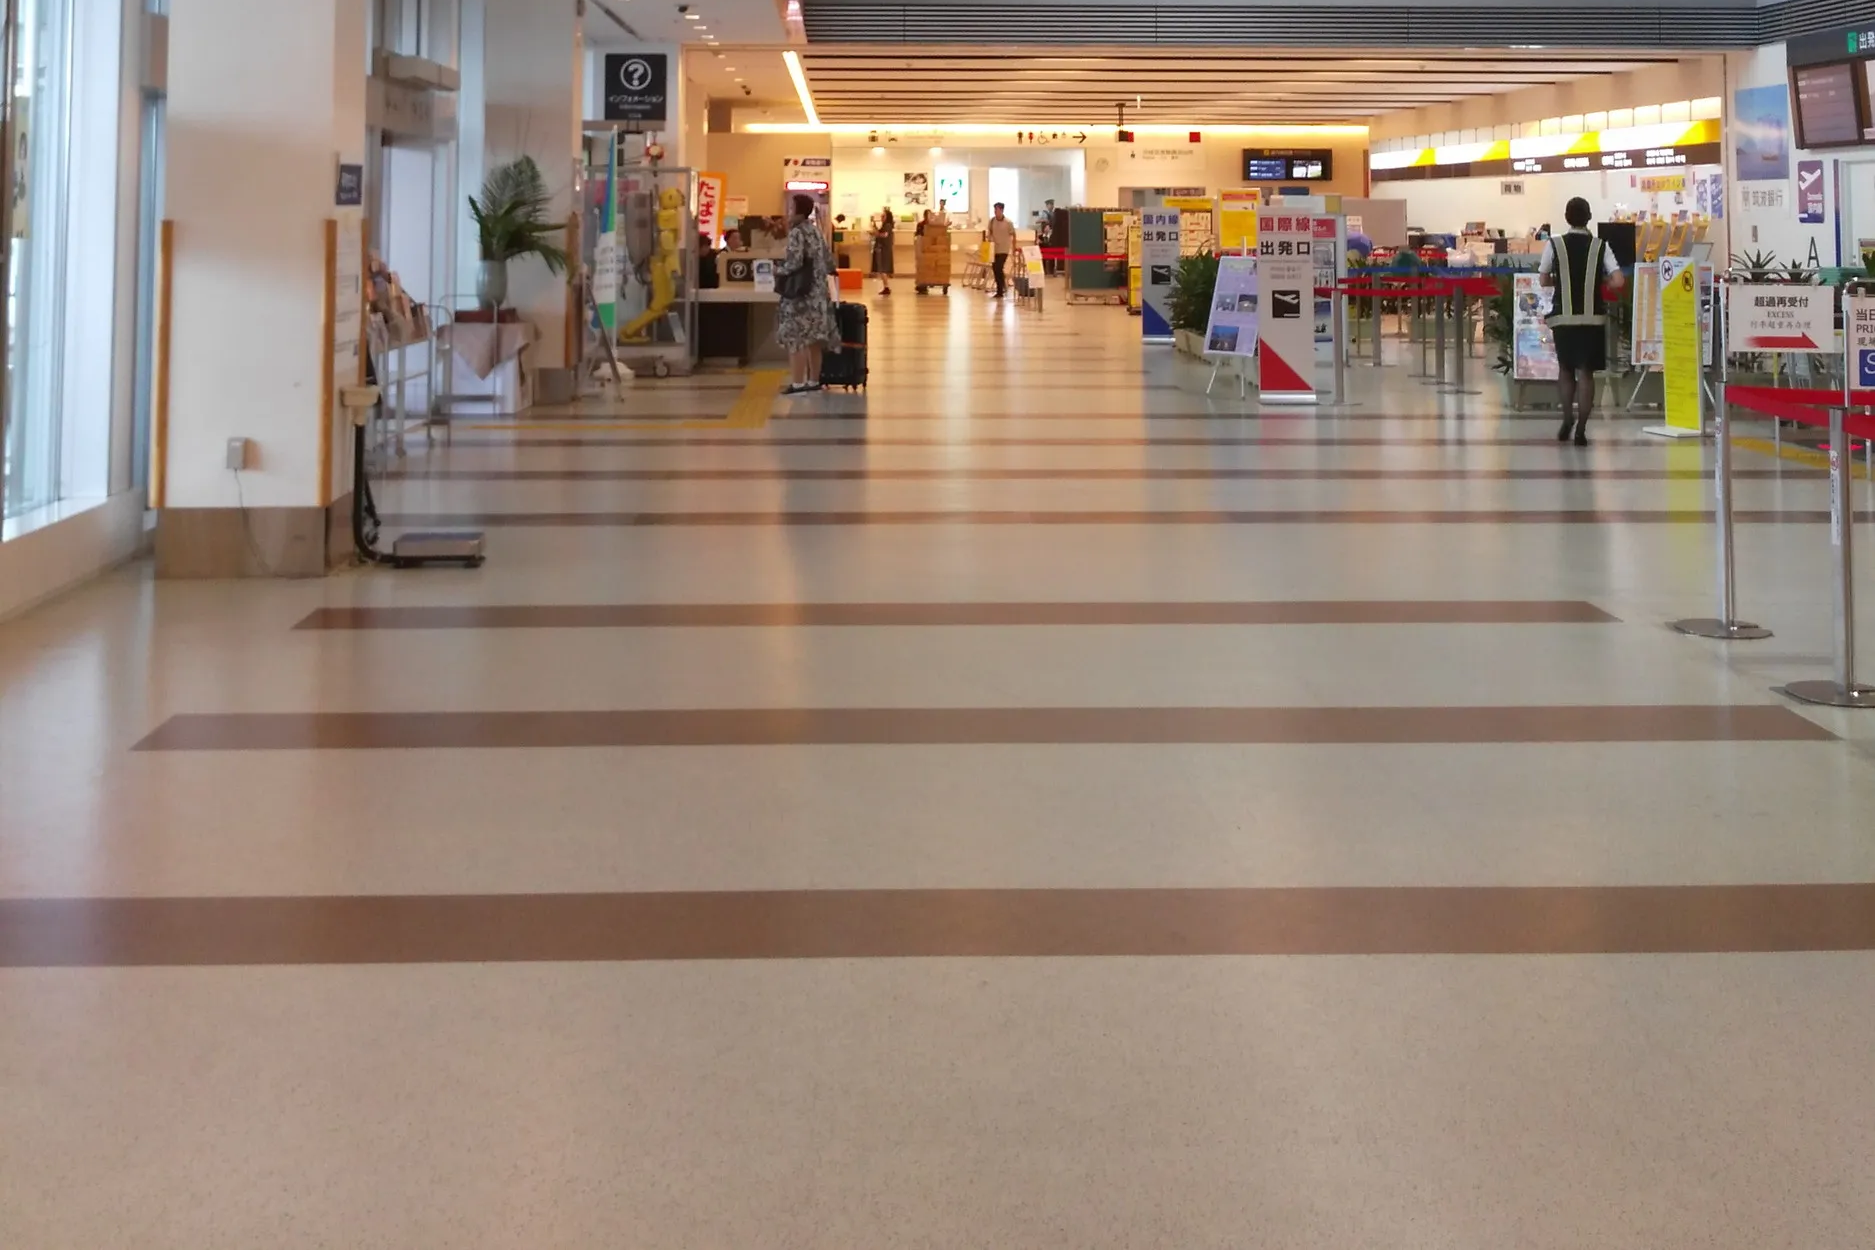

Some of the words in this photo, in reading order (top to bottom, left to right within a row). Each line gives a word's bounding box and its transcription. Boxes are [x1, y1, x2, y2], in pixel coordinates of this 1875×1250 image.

[1143, 214, 1178, 225] 国内線
[1260, 217, 1310, 231] 国際線
[1143, 231, 1178, 241] 出発口
[1260, 241, 1310, 255] 出発口
[1807, 236, 1820, 268] A
[1754, 296, 1809, 307] 超過再受付
